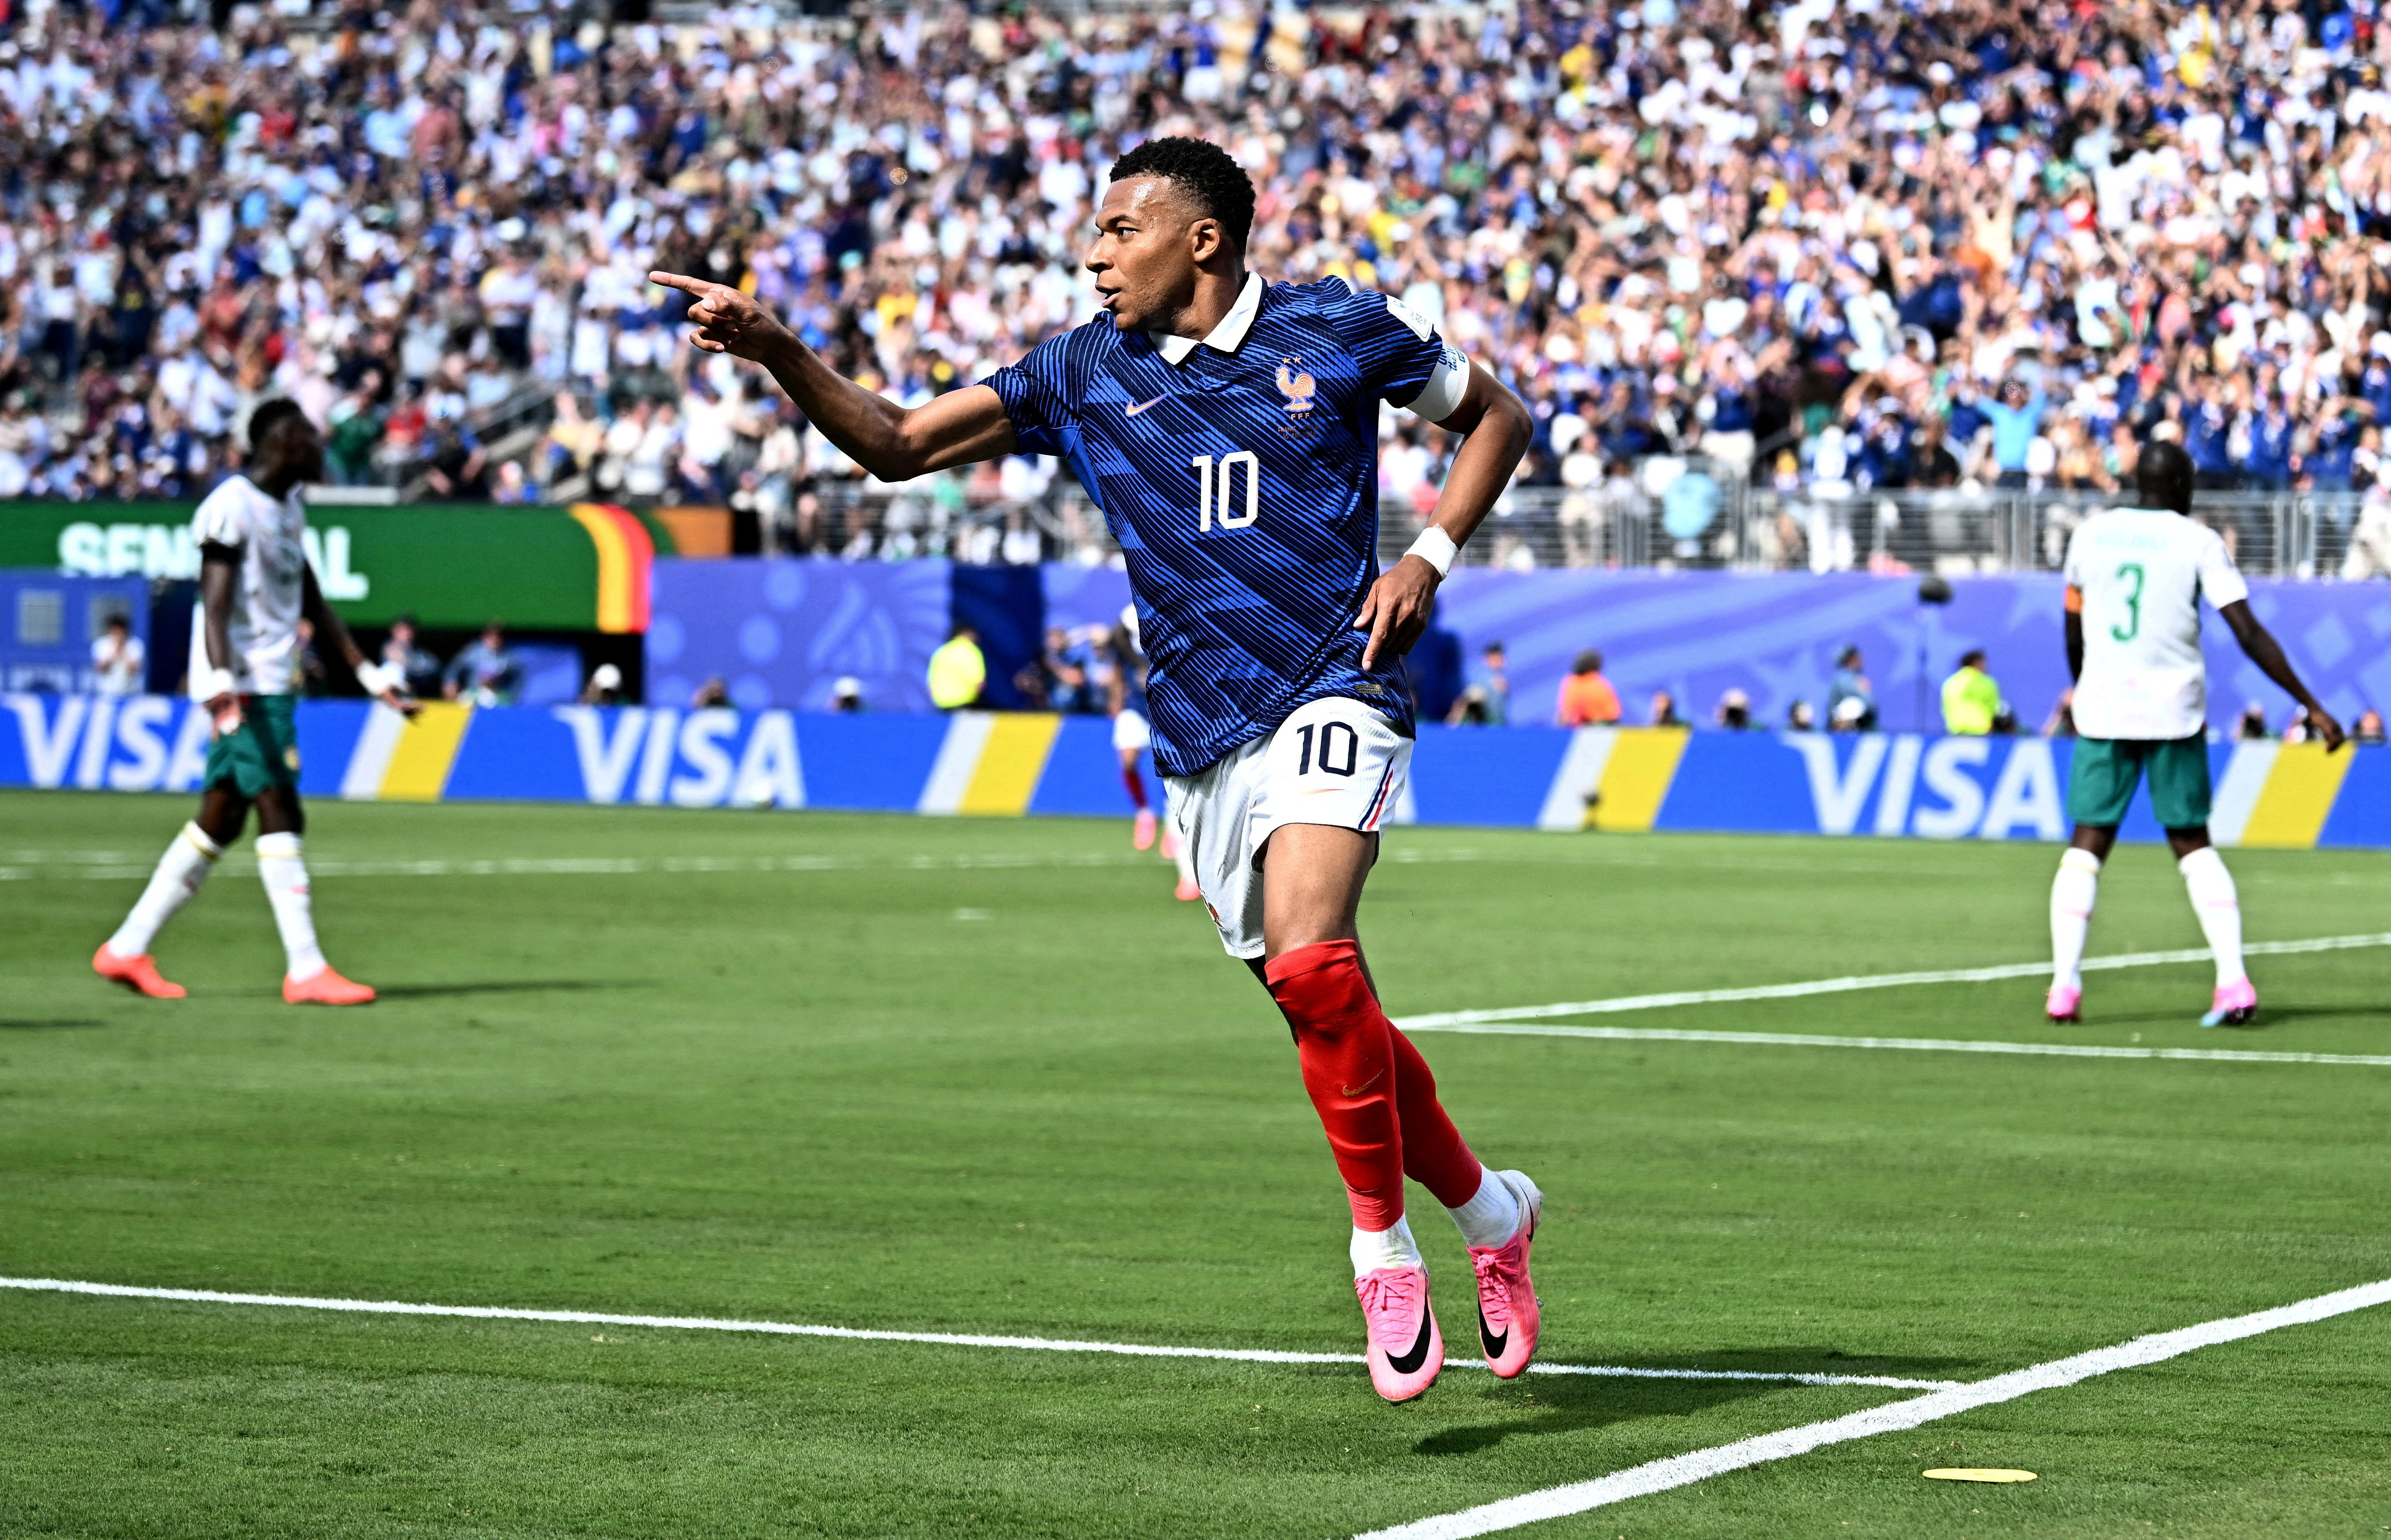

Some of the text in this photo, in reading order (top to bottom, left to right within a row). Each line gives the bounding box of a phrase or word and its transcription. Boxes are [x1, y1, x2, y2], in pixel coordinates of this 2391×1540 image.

[1291, 412, 1310, 421] FFF
[1193, 450, 1259, 532] 10
[2112, 562, 2145, 643] 3
[551, 704, 808, 810] VISA
[1296, 721, 1358, 777] 10
[1781, 732, 2068, 842] VISA
